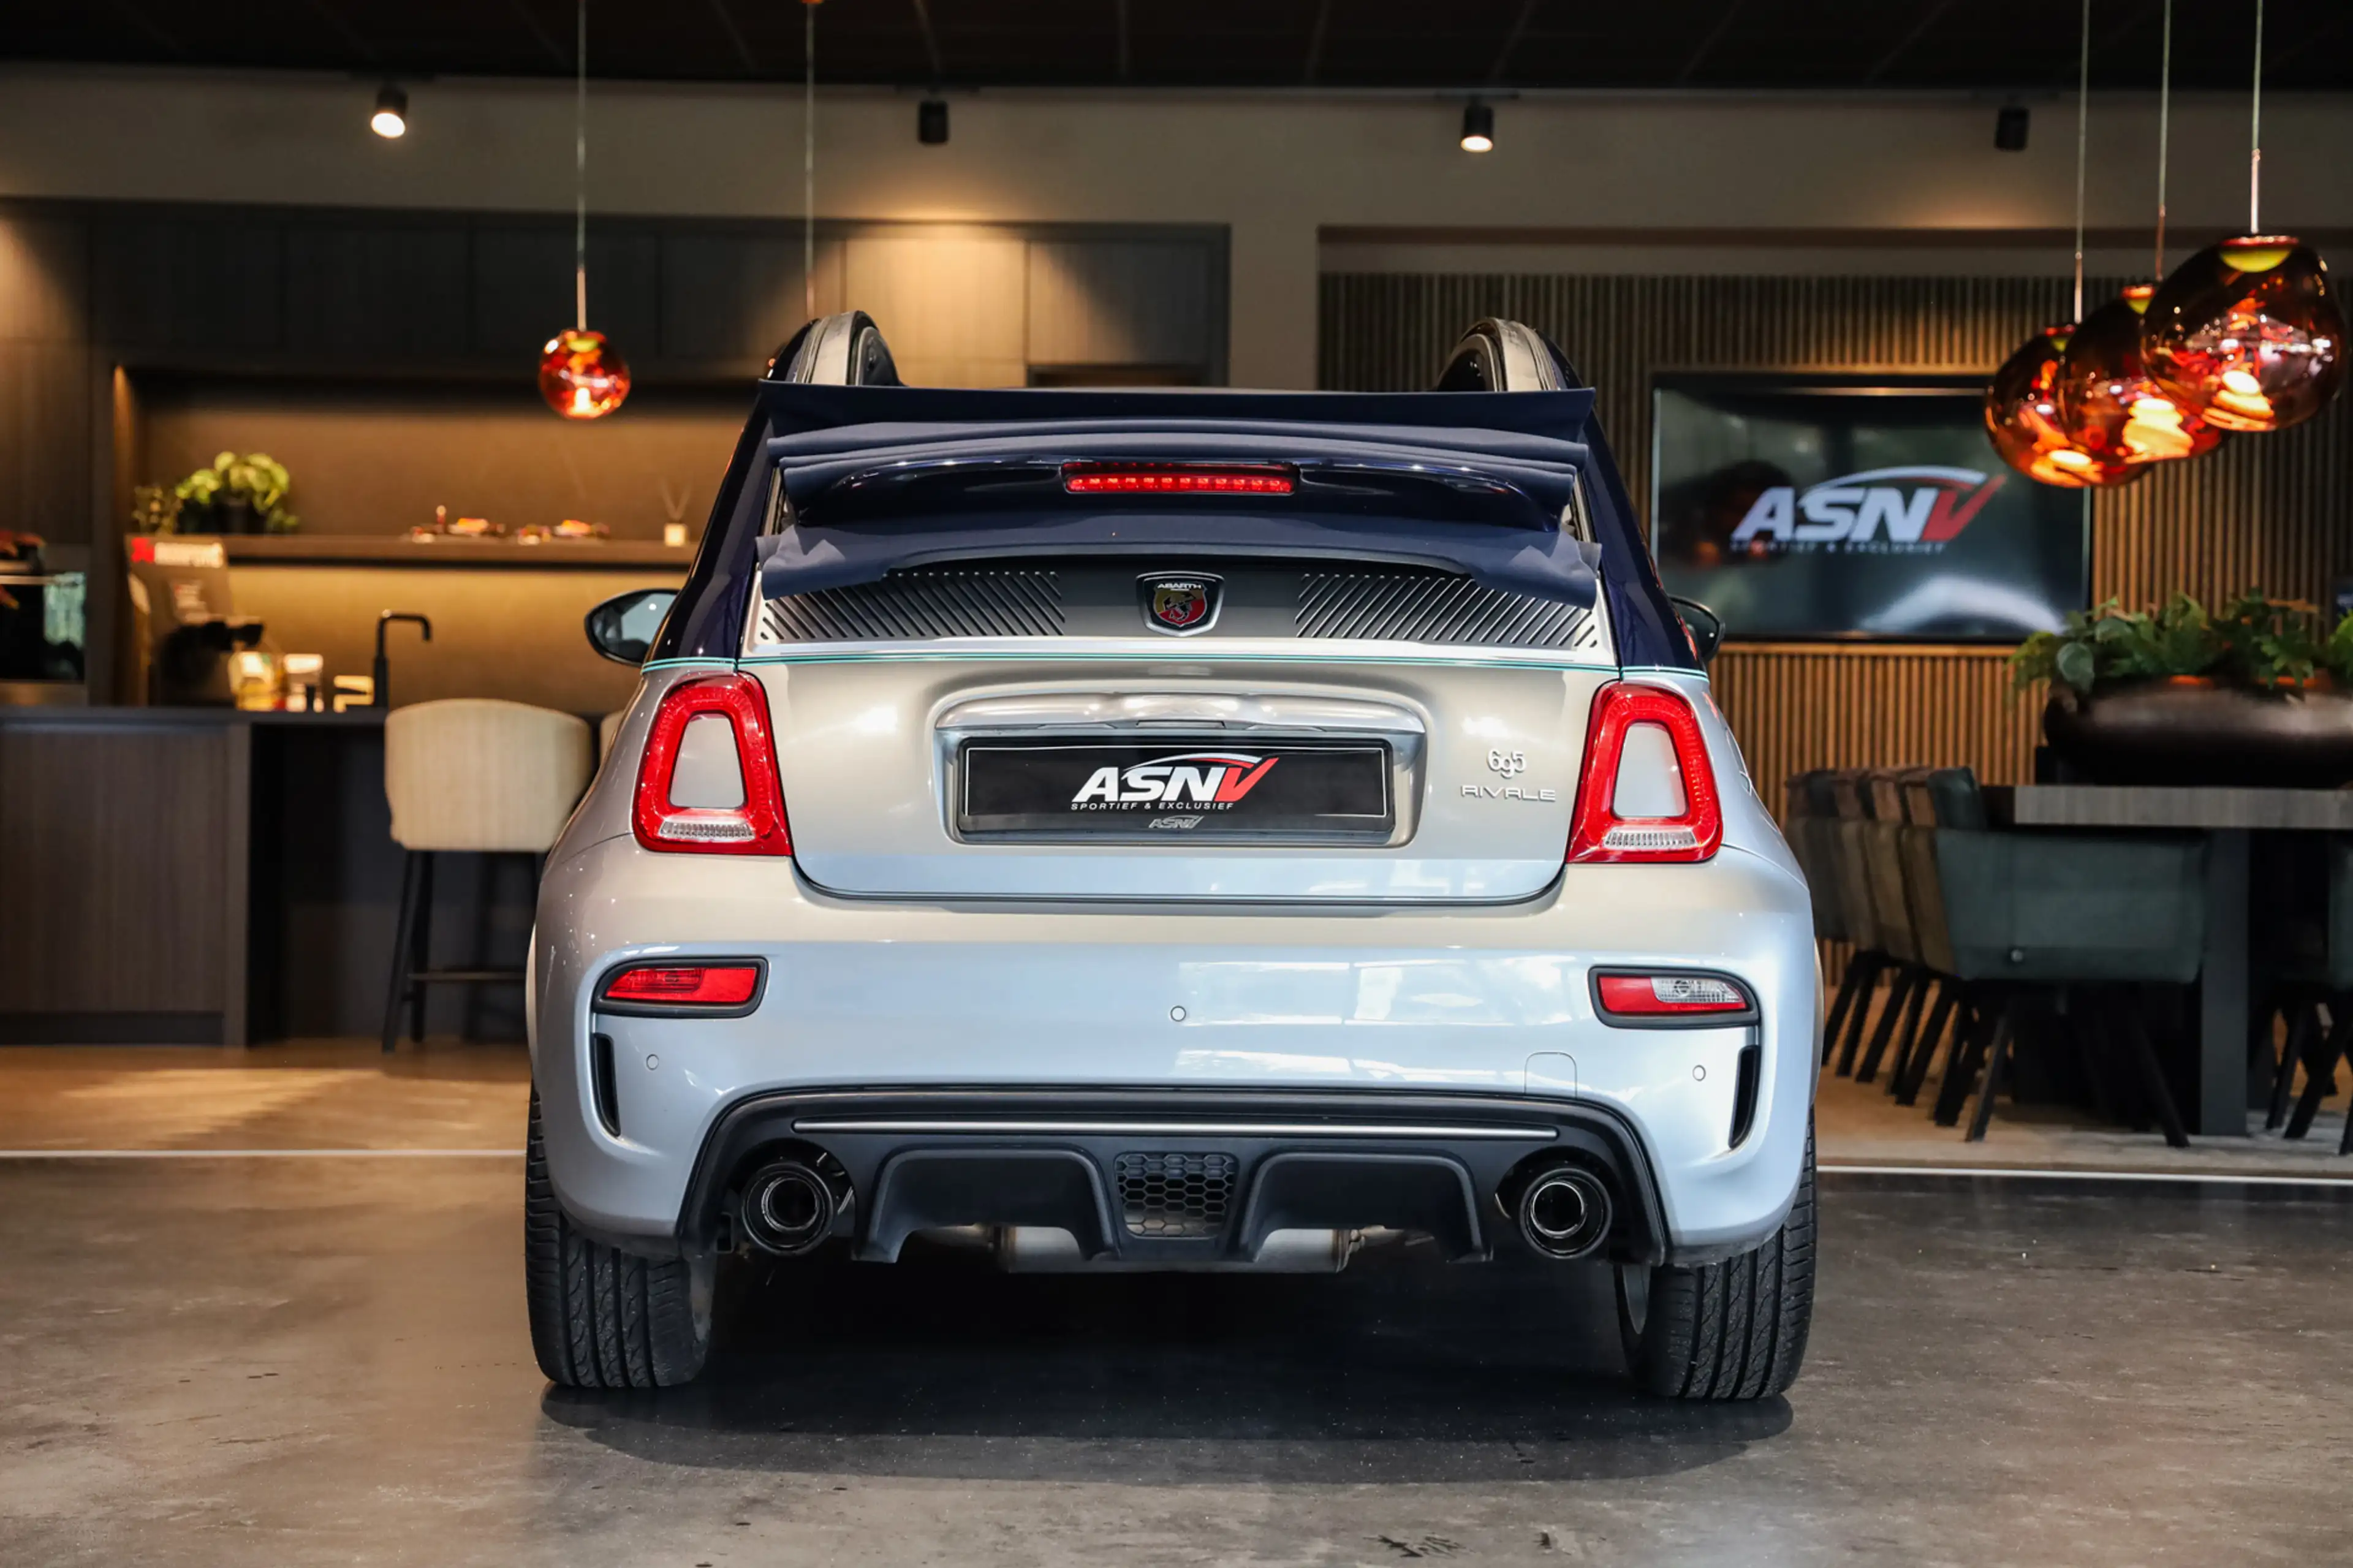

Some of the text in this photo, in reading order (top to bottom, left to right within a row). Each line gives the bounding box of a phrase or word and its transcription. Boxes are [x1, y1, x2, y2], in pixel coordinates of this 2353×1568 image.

[1730, 474, 2007, 542] ASNV
[1072, 757, 1279, 802] ASNV
[1487, 748, 1526, 779] 695
[1460, 785, 1556, 802] RIVALE
